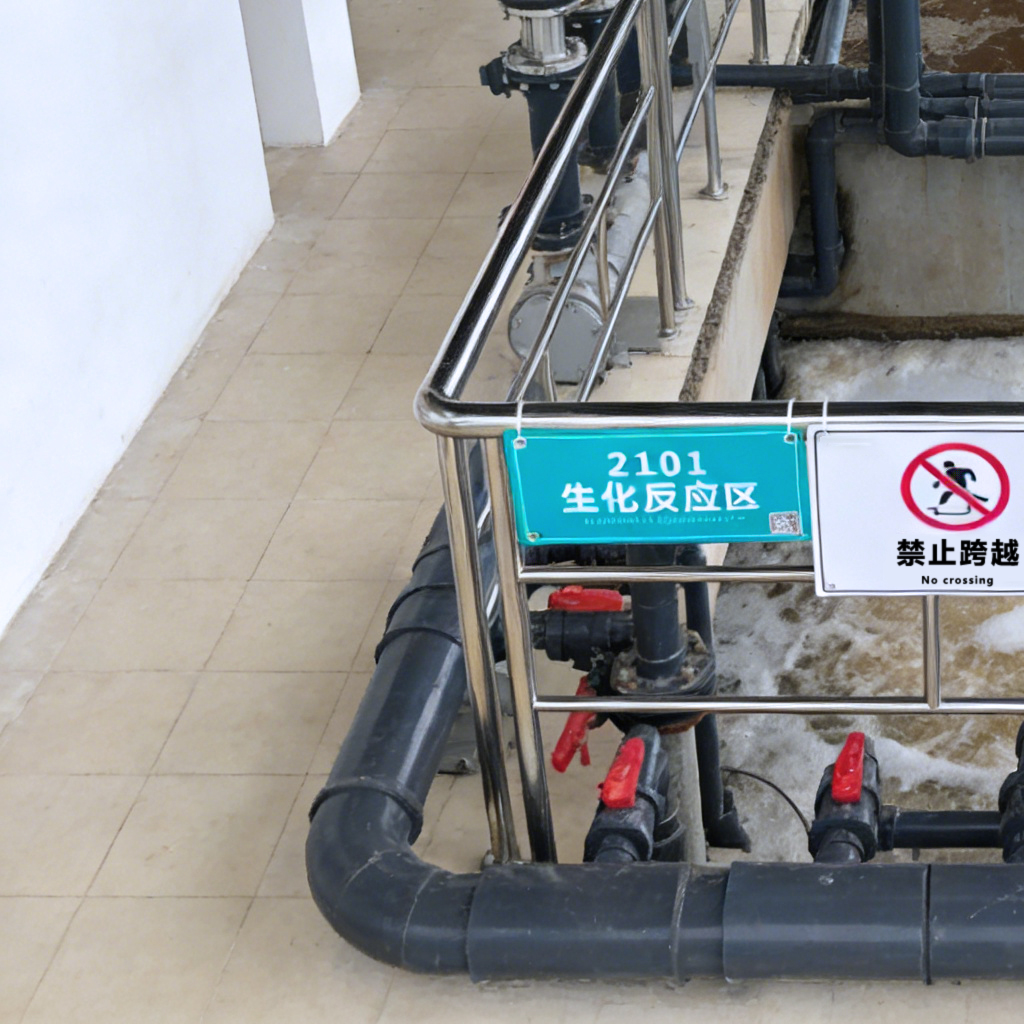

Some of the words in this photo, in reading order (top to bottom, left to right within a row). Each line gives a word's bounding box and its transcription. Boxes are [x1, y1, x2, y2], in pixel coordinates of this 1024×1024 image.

[607, 450, 706, 477] 2101
[561, 479, 760, 514] 生化反应区
[897, 538, 1020, 567] 禁止跨越
[921, 575, 938, 585] No
[943, 575, 994, 587] crossing
